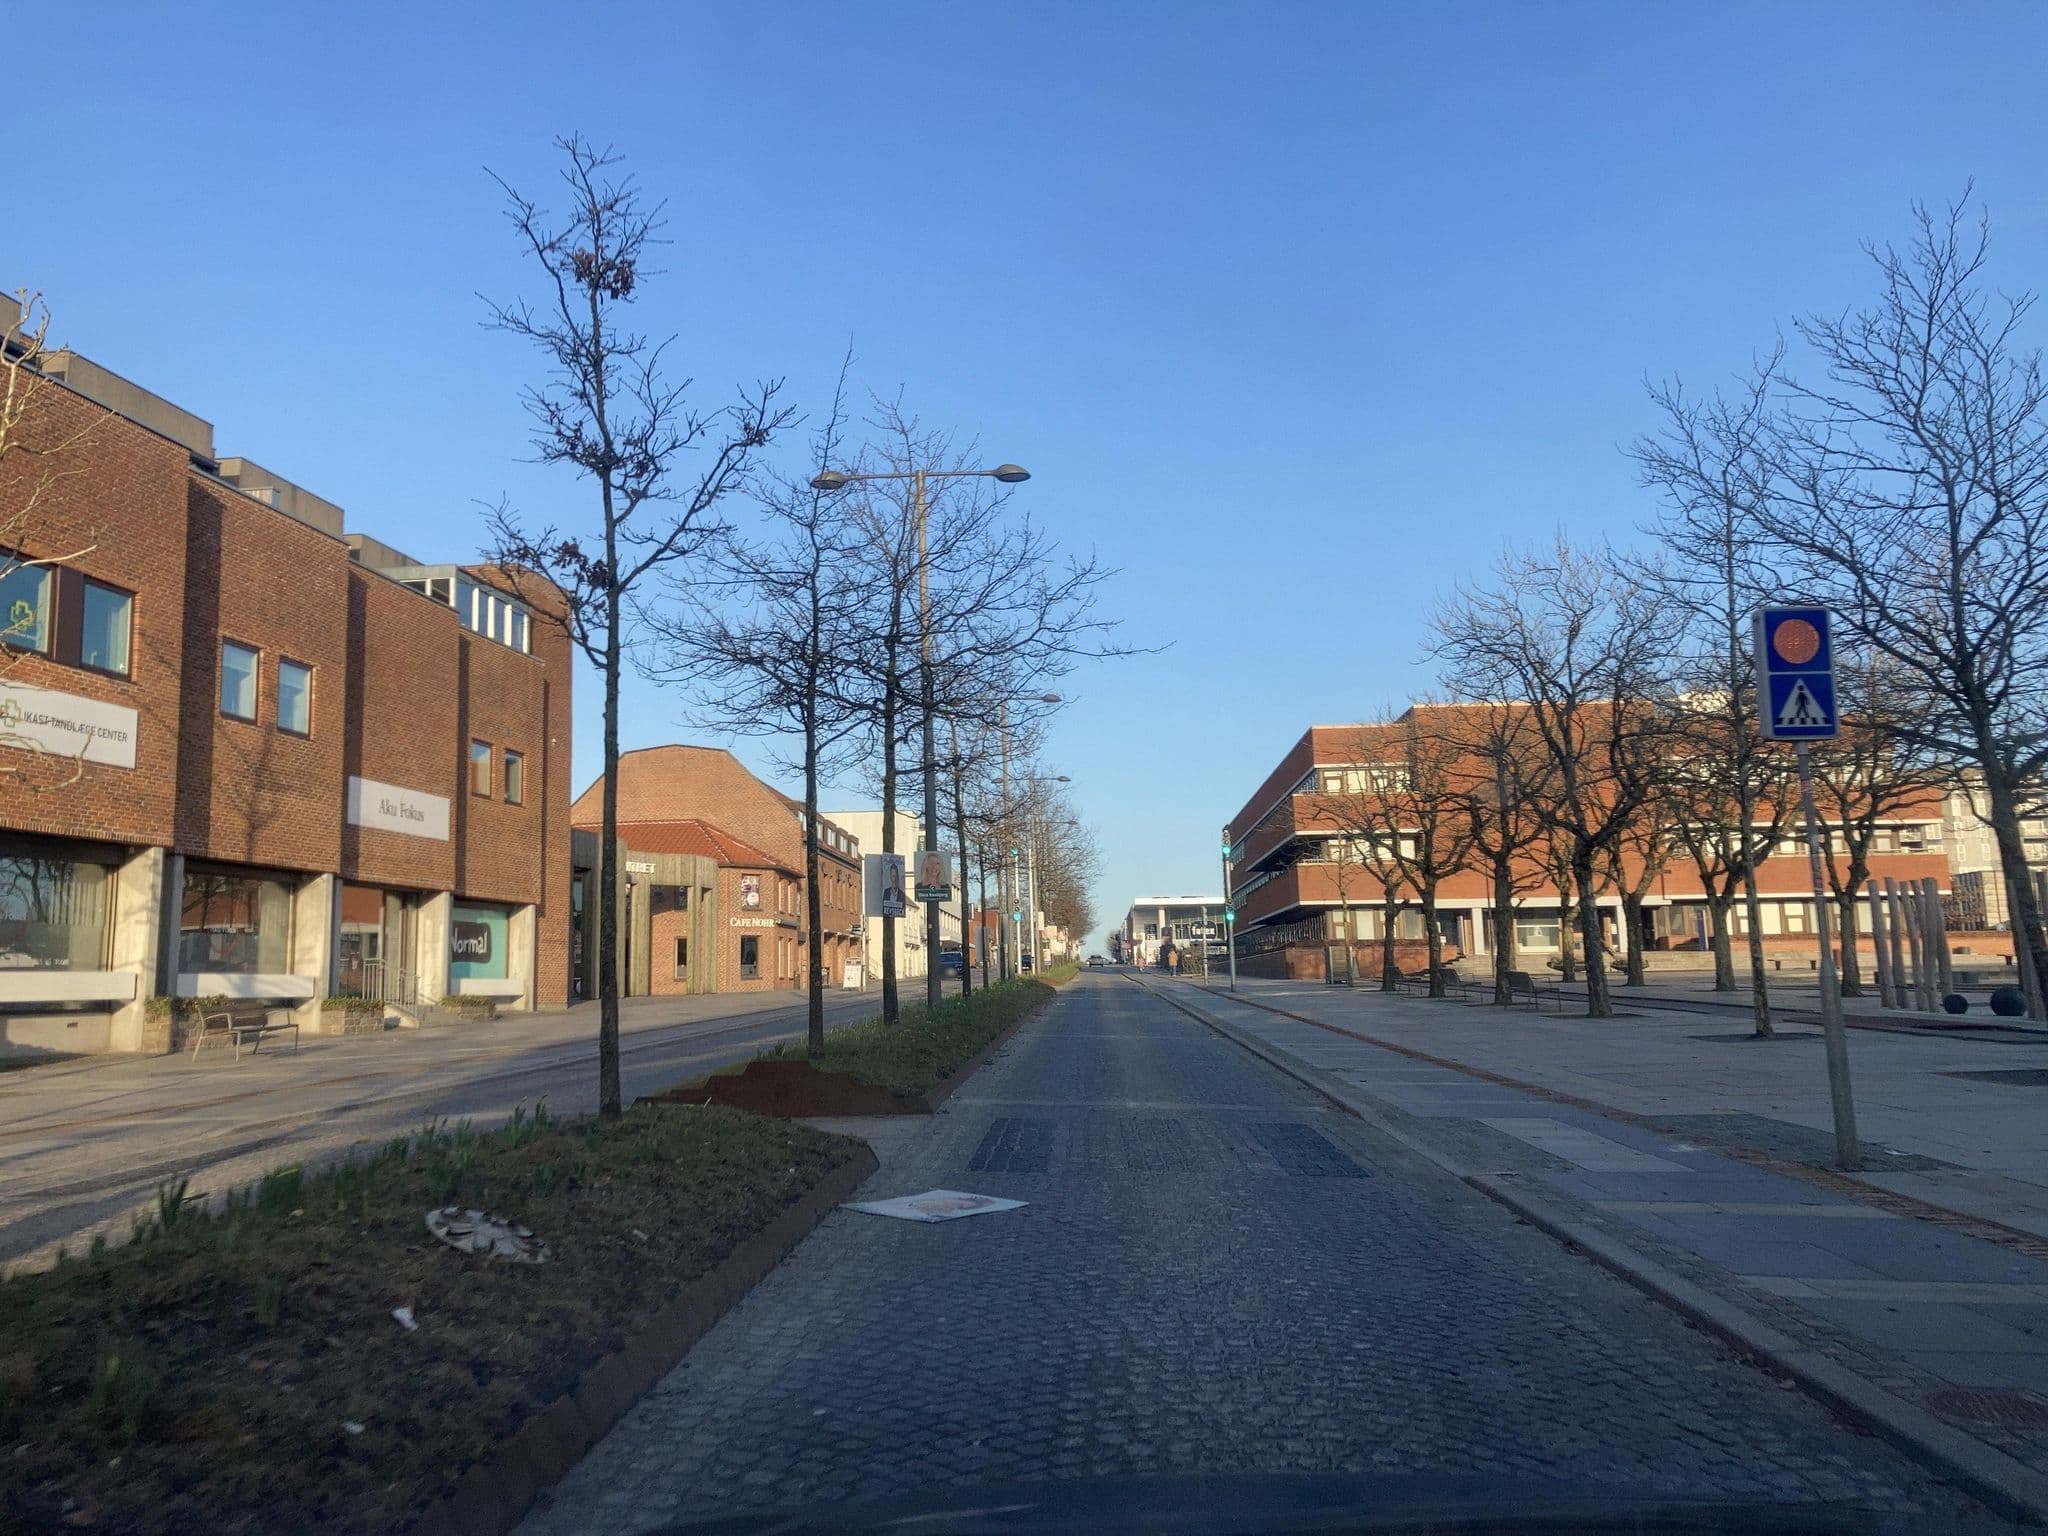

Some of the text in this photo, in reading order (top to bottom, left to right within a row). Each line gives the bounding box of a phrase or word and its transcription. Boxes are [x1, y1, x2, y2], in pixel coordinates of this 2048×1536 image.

[97, 727, 128, 743] CENTER
[379, 799, 424, 822] Aku Fokus
[451, 927, 488, 954] Normal
